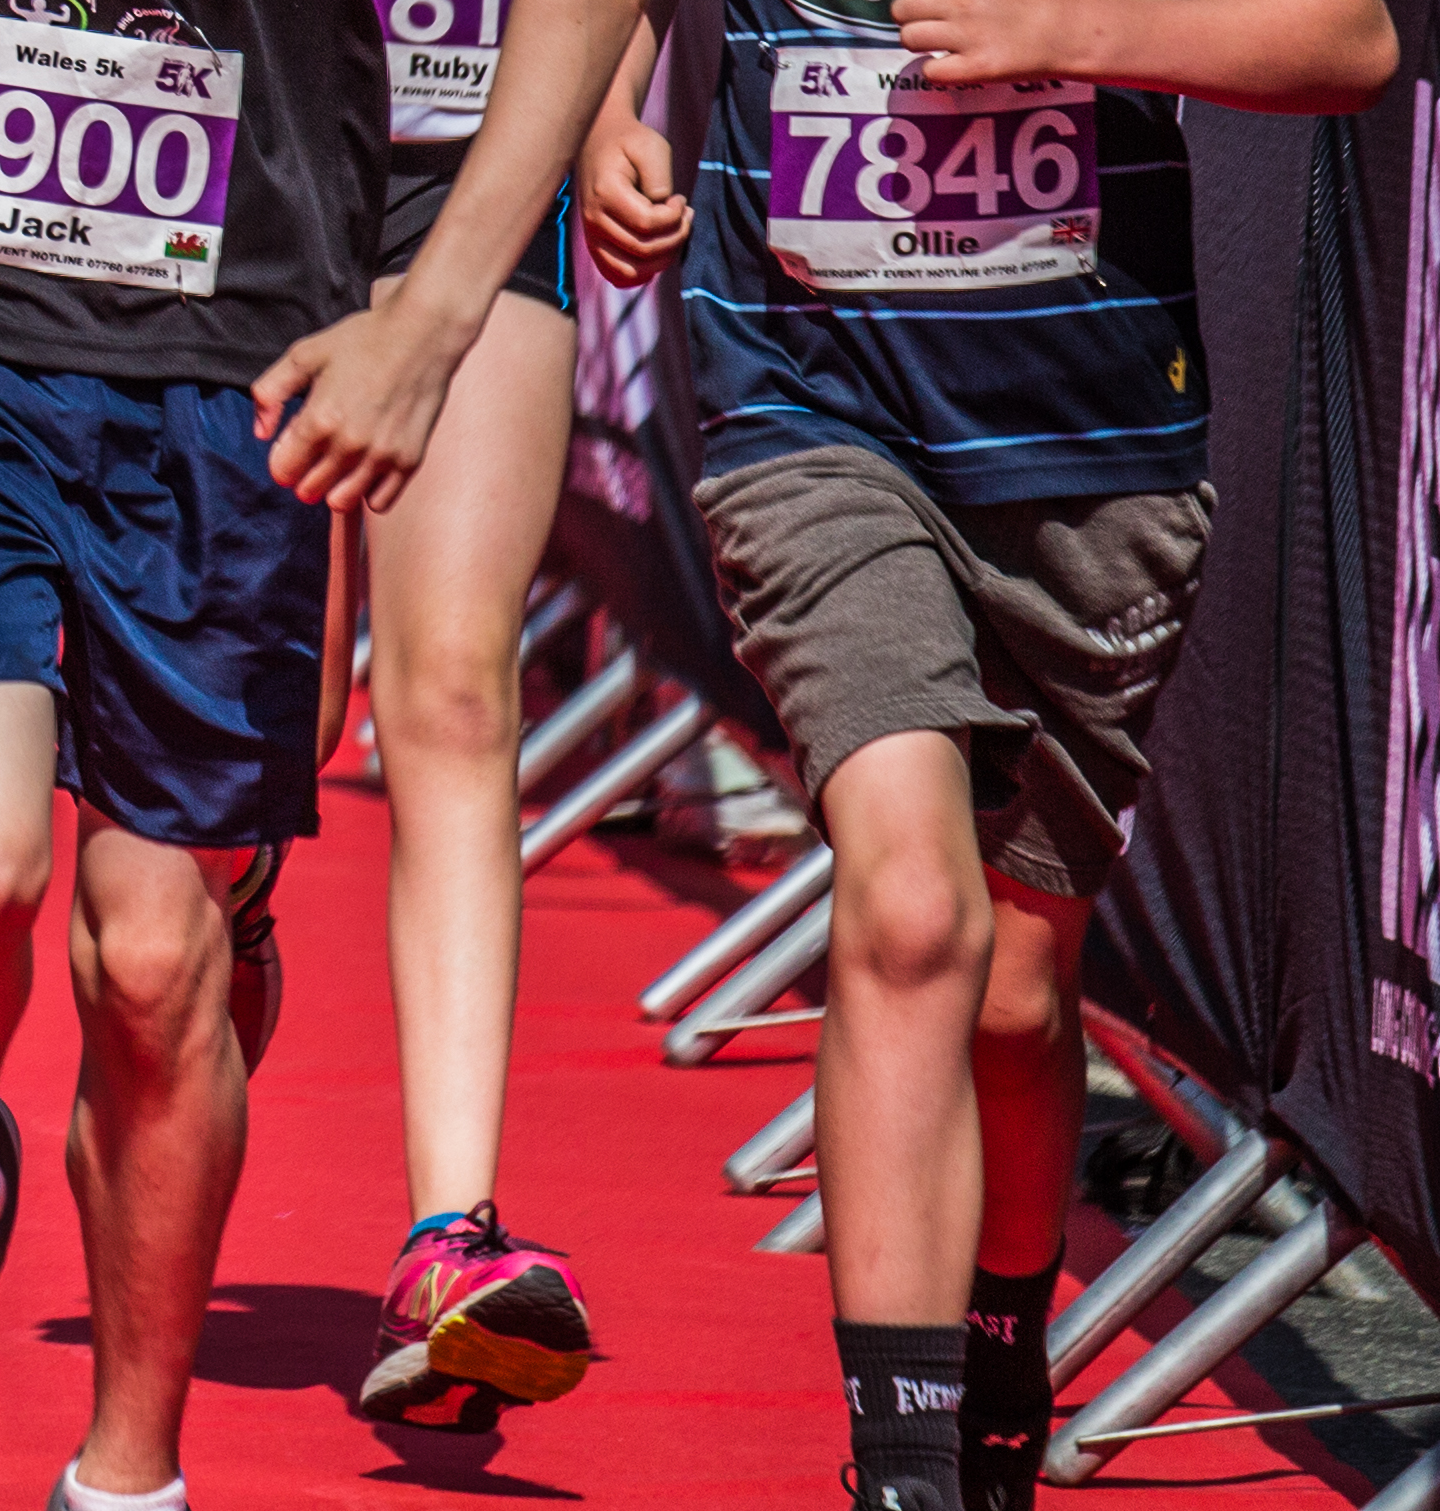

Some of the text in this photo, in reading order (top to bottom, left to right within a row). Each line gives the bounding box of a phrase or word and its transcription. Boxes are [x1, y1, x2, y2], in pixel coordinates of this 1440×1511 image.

[15, 43, 124, 79] Wales 5k
[408, 52, 489, 86] Ruby
[788, 109, 1081, 220] 7846
[31, 250, 84, 267] HOTLINE
[892, 230, 980, 259] Ollie
[883, 269, 924, 279] EVENT
